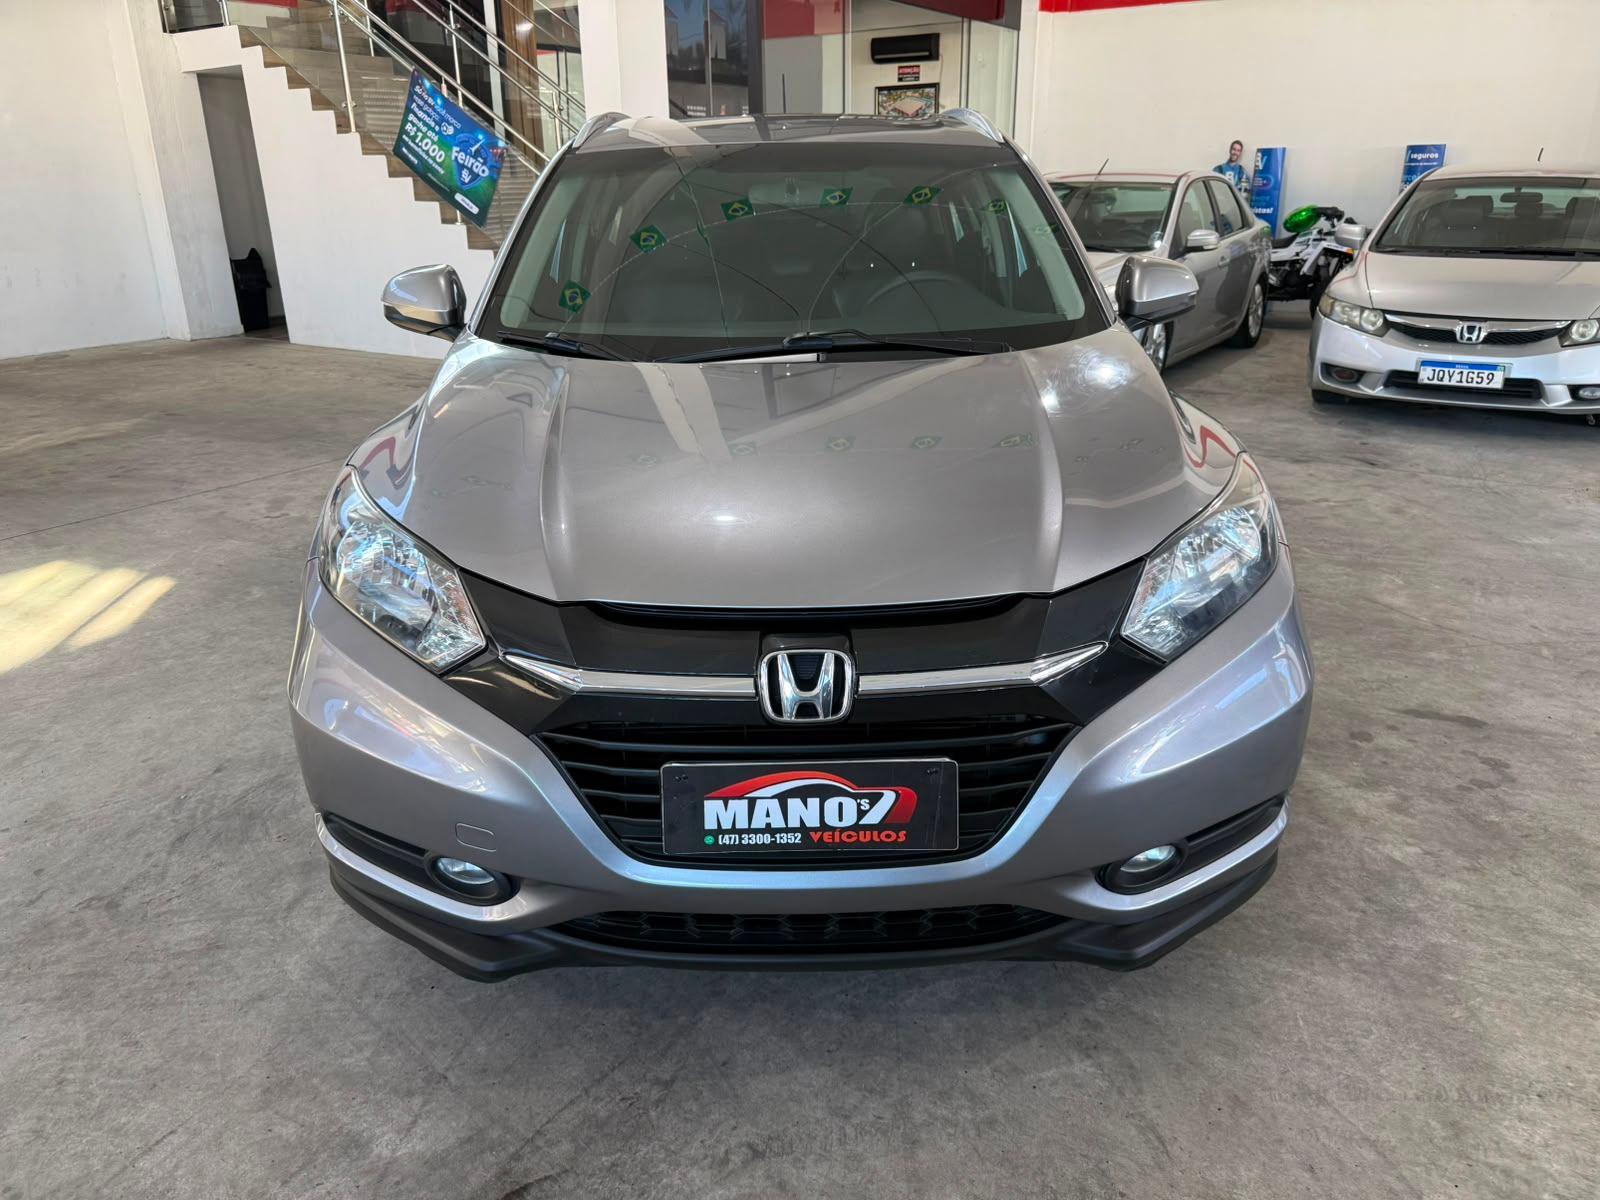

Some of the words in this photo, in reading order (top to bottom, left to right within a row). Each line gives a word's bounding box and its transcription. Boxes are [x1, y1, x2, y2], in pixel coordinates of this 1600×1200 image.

[415, 132, 445, 162] 1.000
[452, 146, 490, 177] Feirão
[1410, 152, 1439, 160] seguros
[1427, 368, 1494, 385] JQY1G59
[718, 833, 740, 846] (47)
[741, 832, 803, 845] 3300-1352
[808, 829, 908, 844] VEÍCULOS
